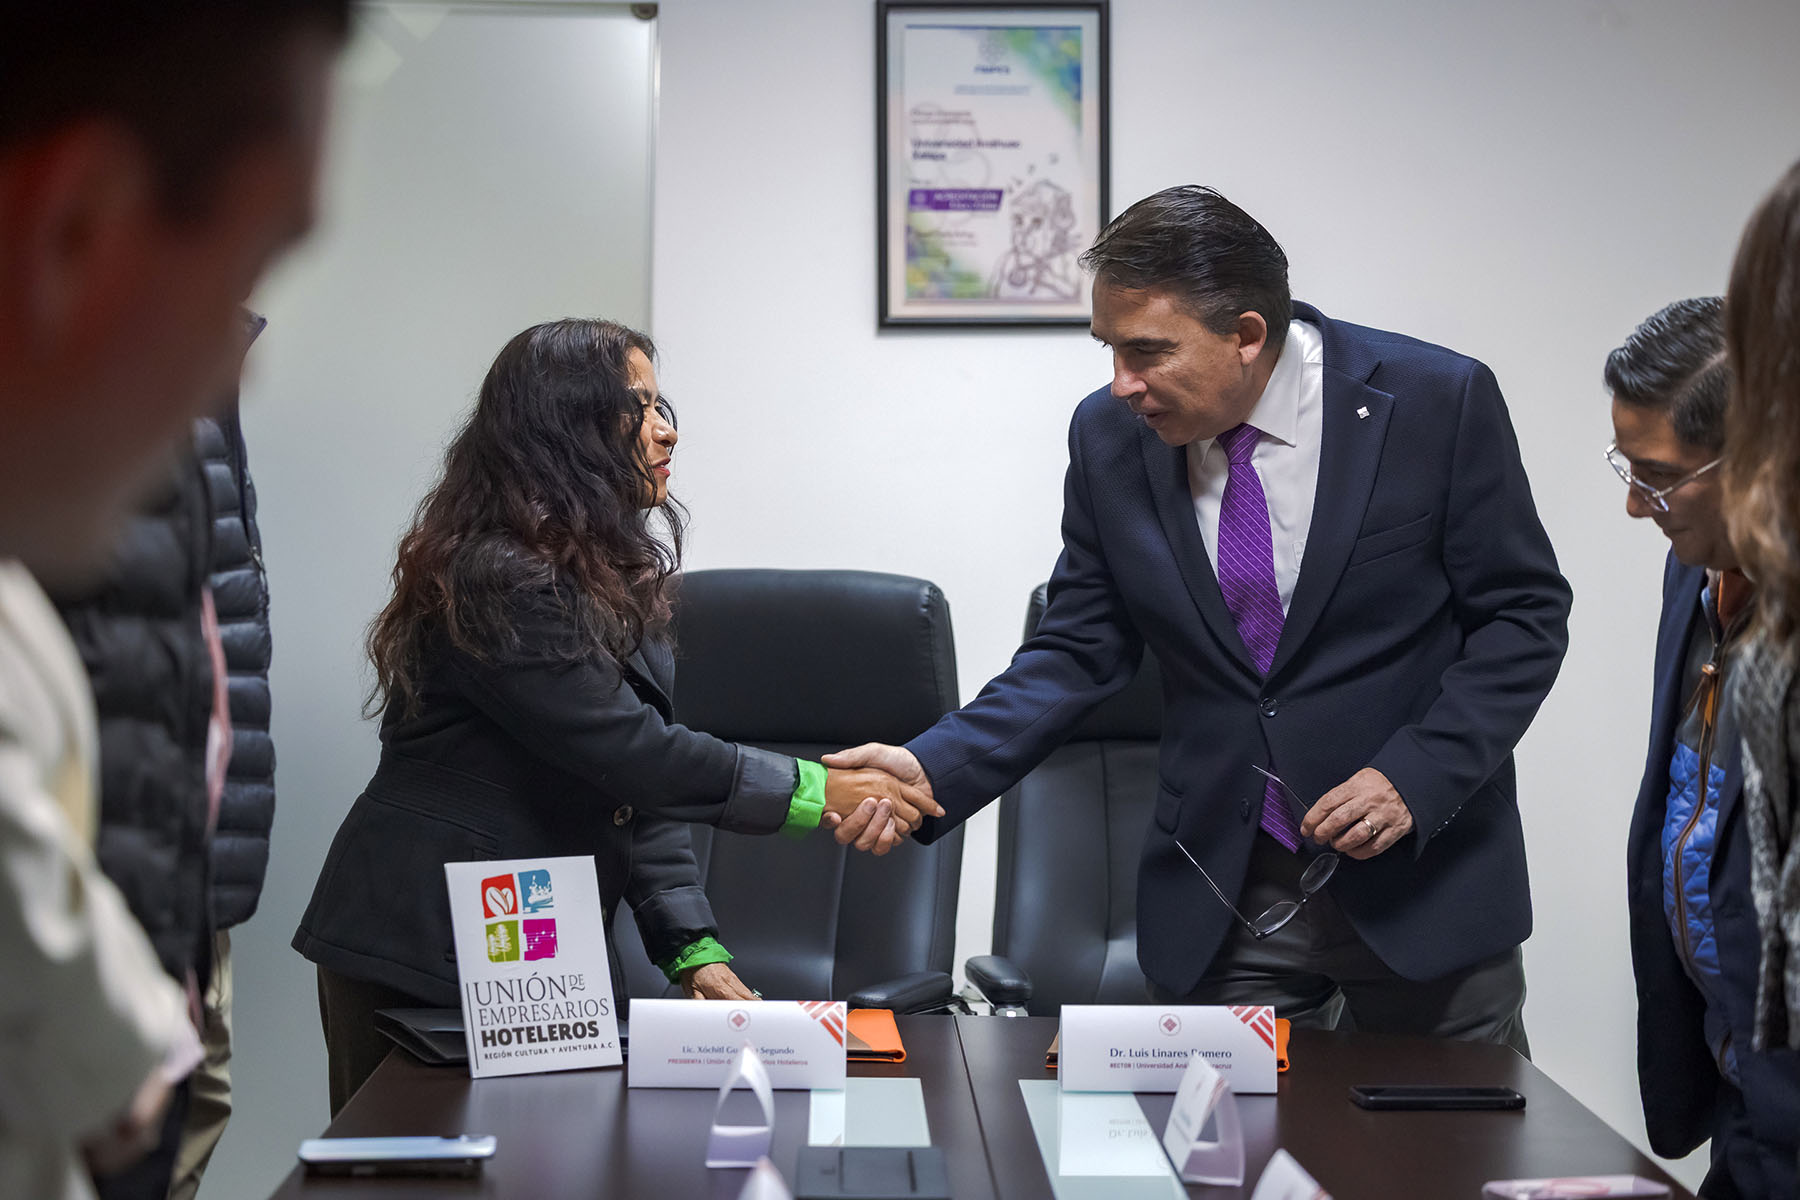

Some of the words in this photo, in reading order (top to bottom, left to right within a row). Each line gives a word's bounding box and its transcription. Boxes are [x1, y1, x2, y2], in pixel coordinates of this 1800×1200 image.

[473, 972, 568, 1006] UNIÓN
[569, 974, 586, 991] DE
[478, 998, 609, 1026] EMPRESARIOS
[481, 1020, 600, 1048] HOTELEROS
[484, 1049, 513, 1060] REGIÓN
[515, 1048, 549, 1057] CULTURA
[558, 1044, 598, 1053] AVENTURA
[600, 1041, 616, 1050] A.C.
[682, 1045, 695, 1054] Lic.
[697, 1045, 725, 1054] Xóchitl
[760, 1046, 795, 1056] Segundo
[1109, 1047, 1126, 1058] Dr.
[1129, 1047, 1149, 1058] Luis
[1152, 1047, 1188, 1058] Linares
